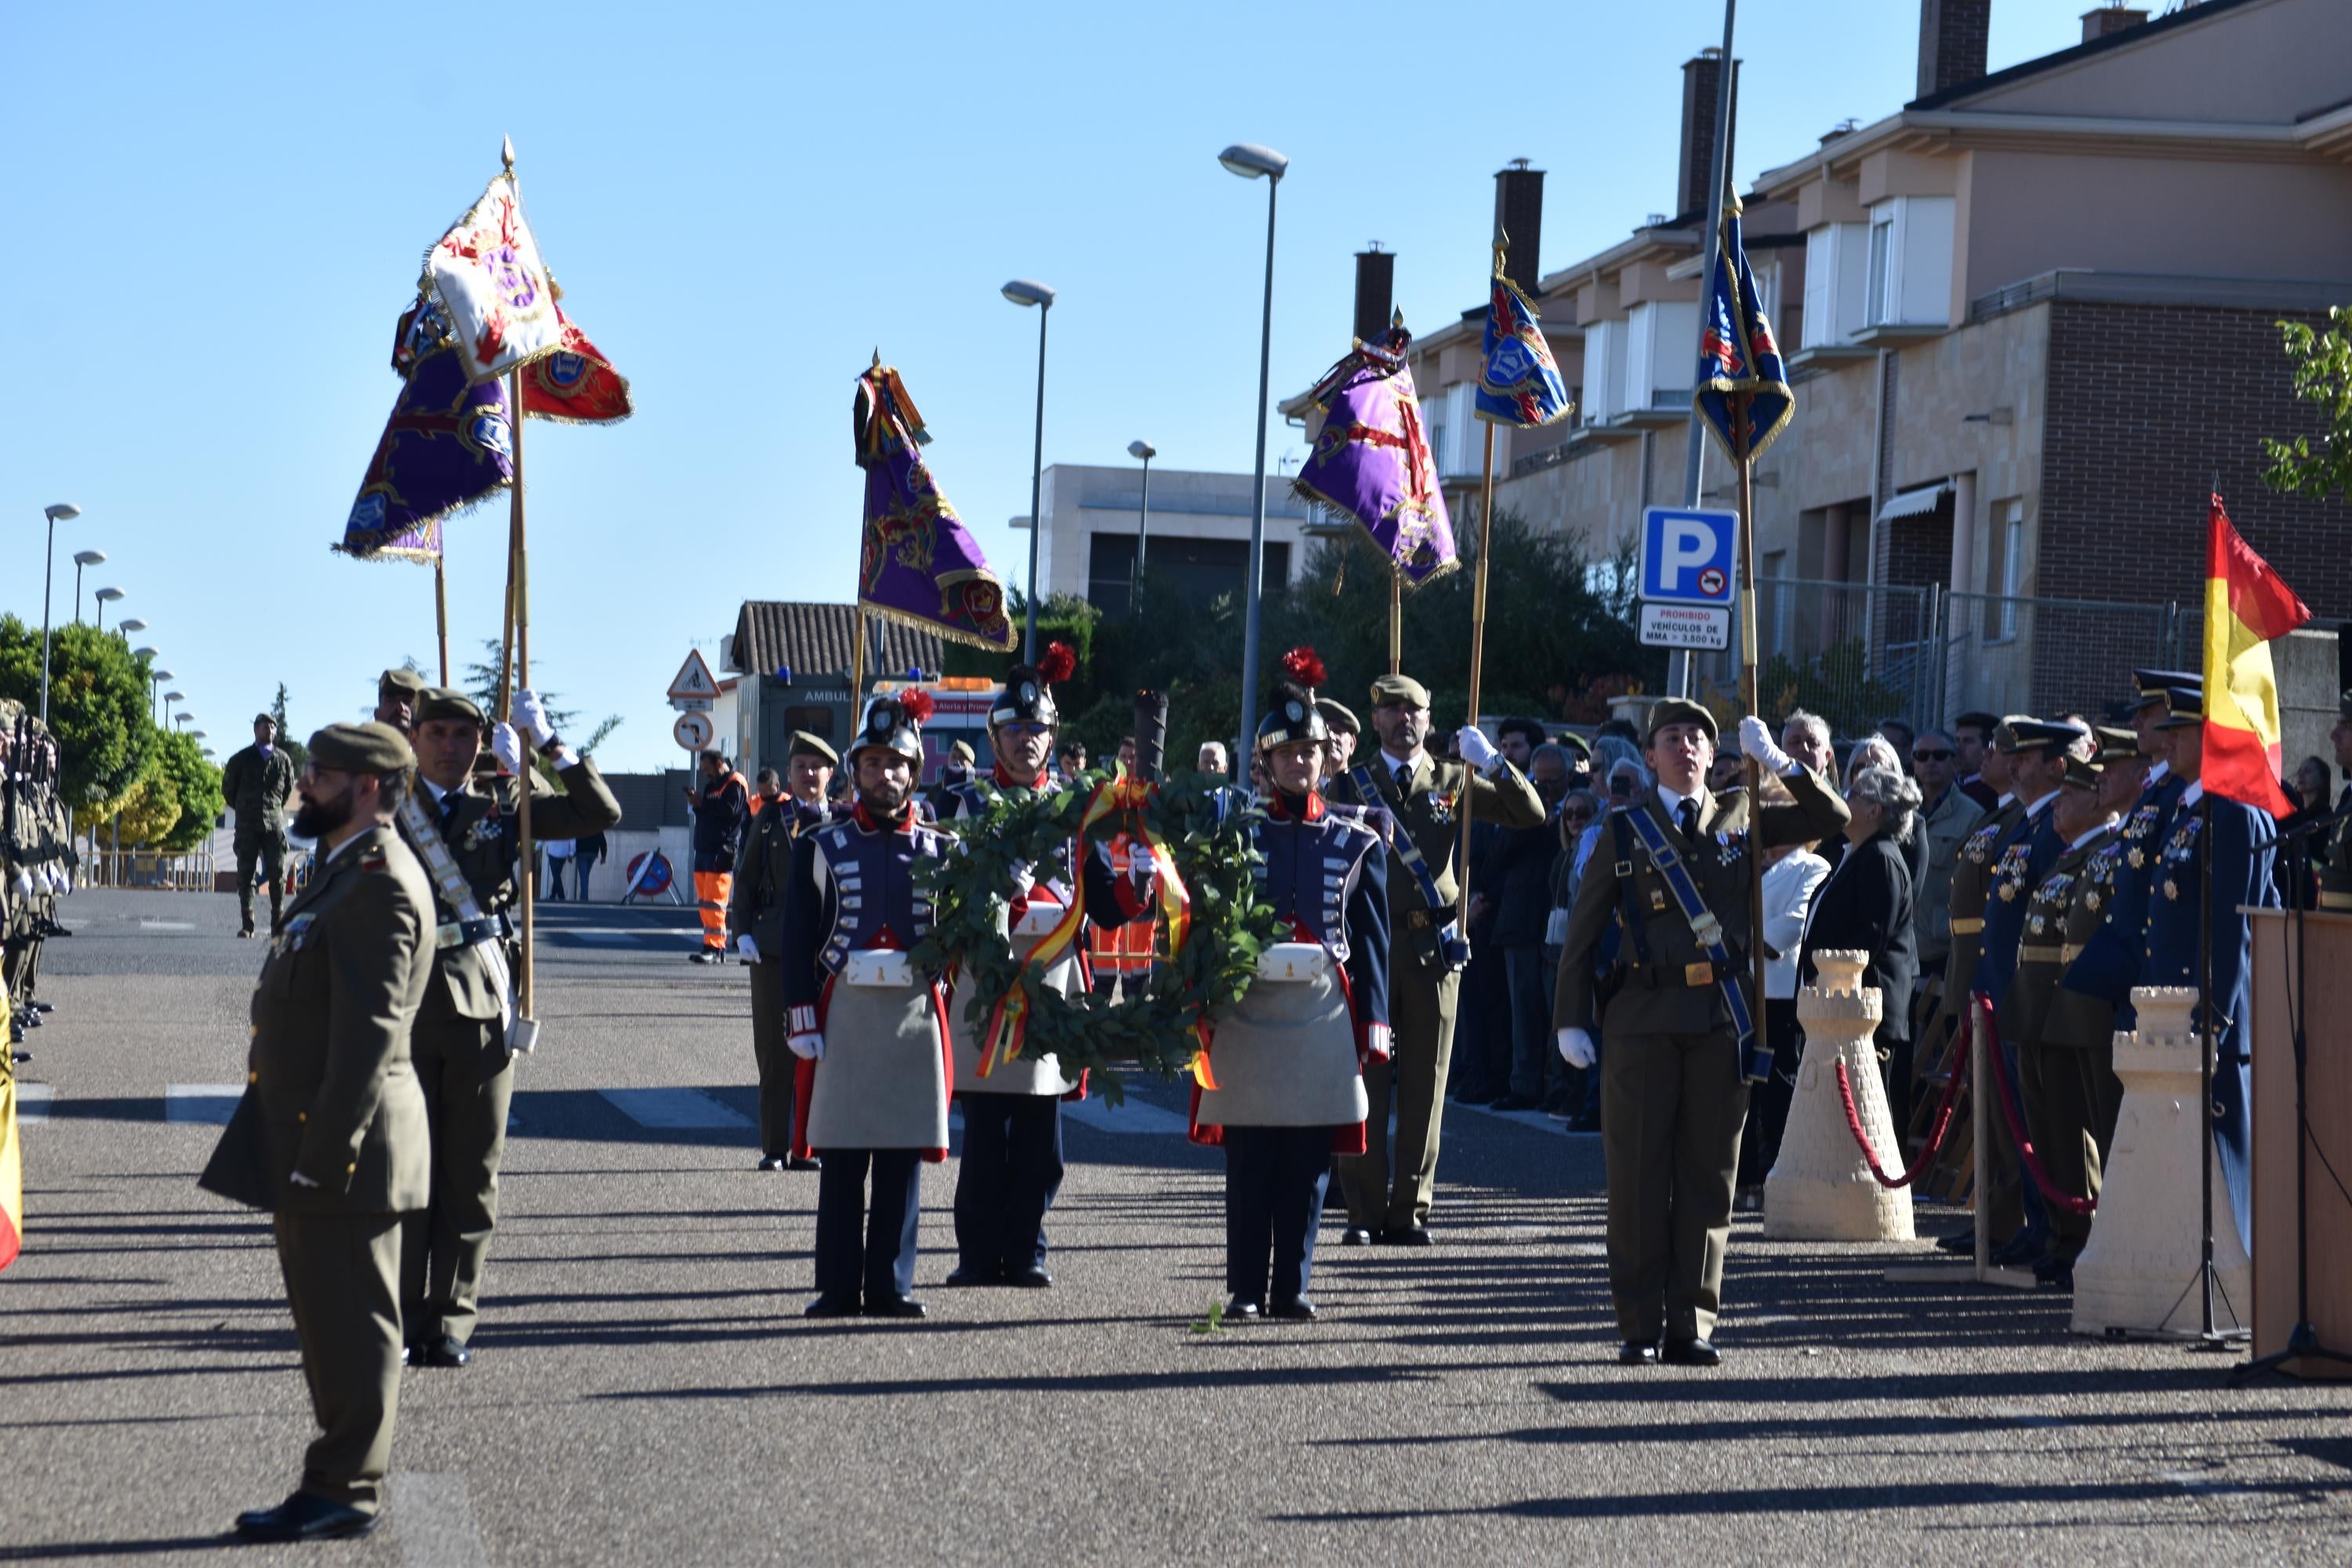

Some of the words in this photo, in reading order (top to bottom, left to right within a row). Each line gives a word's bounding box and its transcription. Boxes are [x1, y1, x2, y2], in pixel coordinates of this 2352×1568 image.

[1660, 518, 1717, 590] P
[1660, 609, 1710, 621] PROHIBIDO
[1651, 622, 1701, 633] VEHÍCULOS
[1706, 625, 1719, 634] DE
[1646, 632, 1668, 641] MMA
[1711, 637, 1722, 646] kg
